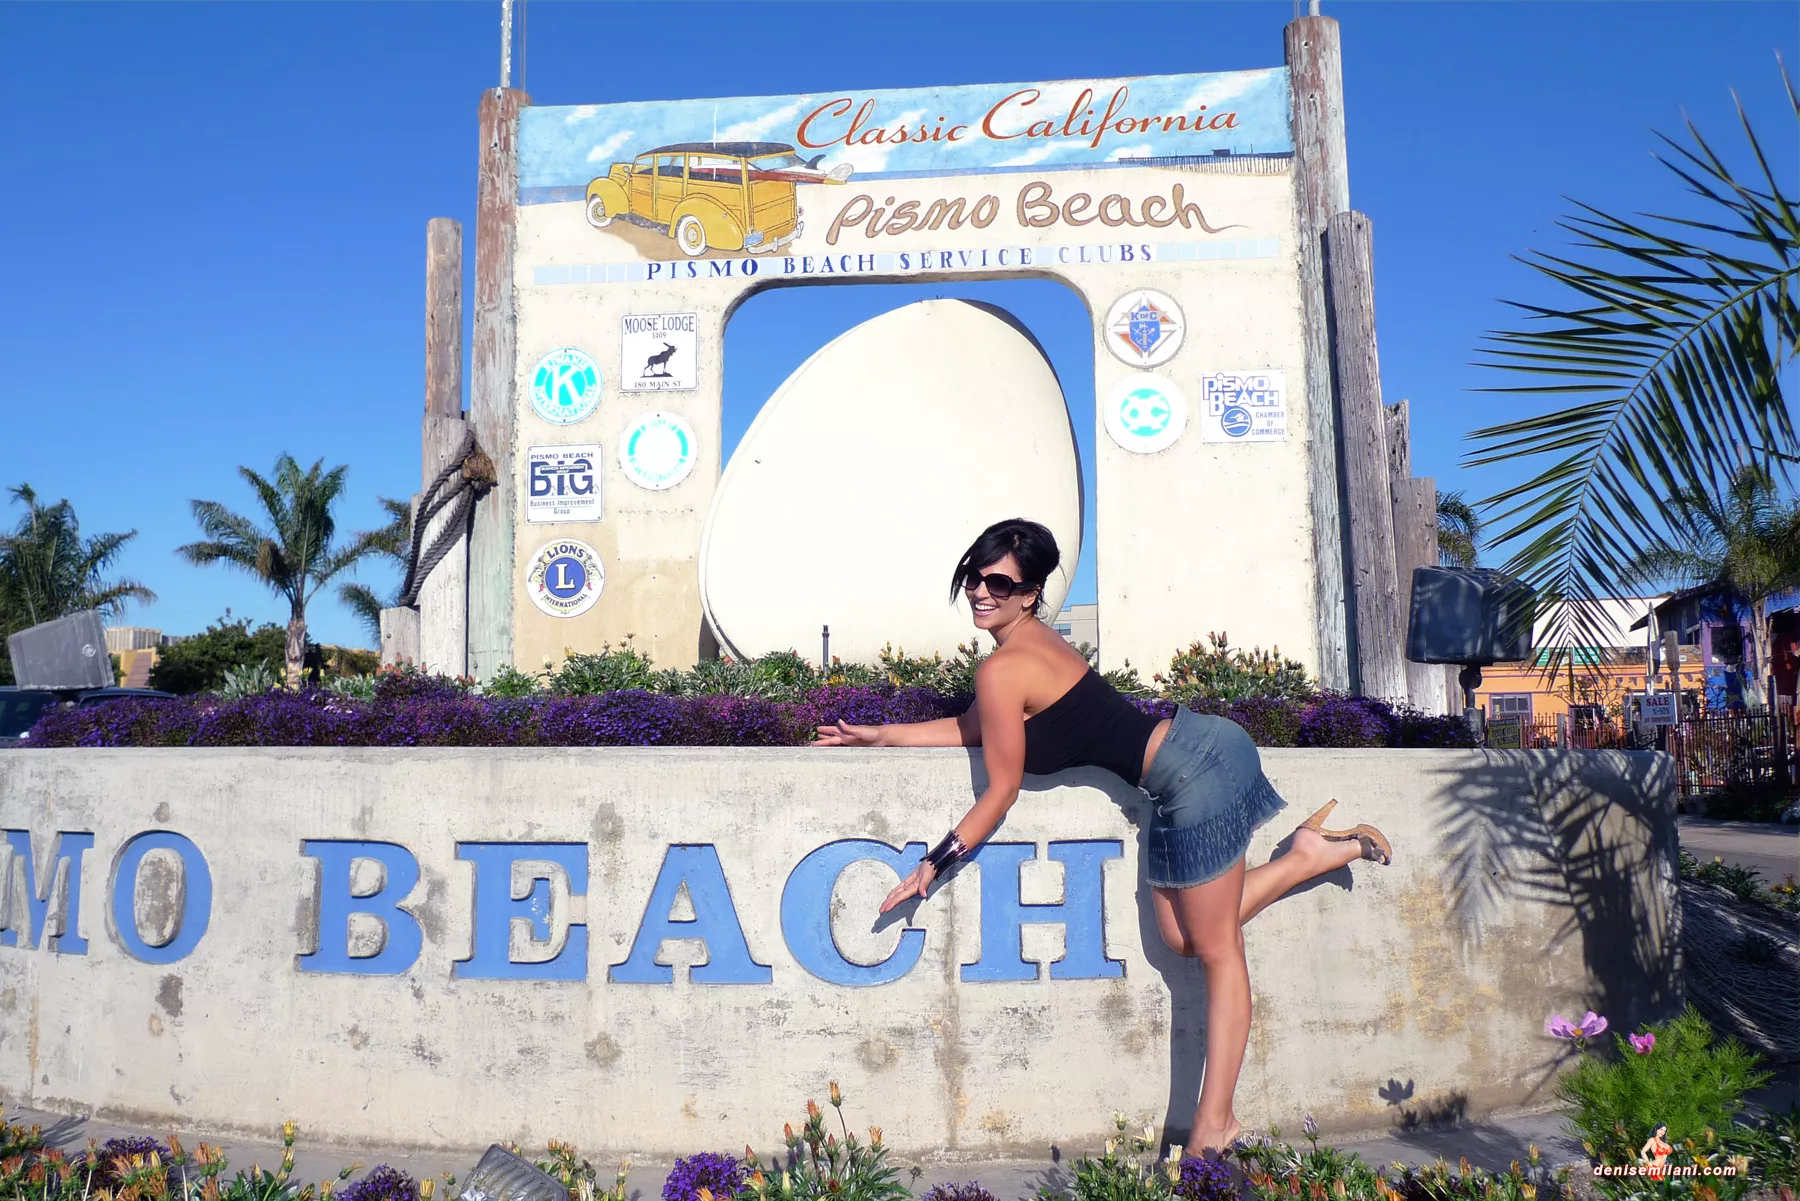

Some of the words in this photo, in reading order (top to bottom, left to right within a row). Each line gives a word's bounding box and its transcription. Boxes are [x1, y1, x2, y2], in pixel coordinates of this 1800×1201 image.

[796, 98, 971, 150] Classic
[981, 85, 1240, 150] California
[825, 193, 1001, 246] Pismo
[1016, 181, 1251, 235] Beach
[646, 258, 759, 281] PISMO
[783, 253, 875, 274] BEACH
[899, 247, 1033, 271] SERVICE
[1058, 244, 1152, 265] CLUBS
[624, 317, 659, 335] MOOSE
[662, 315, 695, 332] LODGE
[652, 332, 667, 340] 1409
[551, 364, 583, 406] K
[546, 544, 585, 559] LIONS
[555, 563, 576, 590] L
[543, 593, 588, 608] INTERNATIONAL
[1646, 697, 1669, 706] SALE
[295, 838, 1127, 987] BEACH
